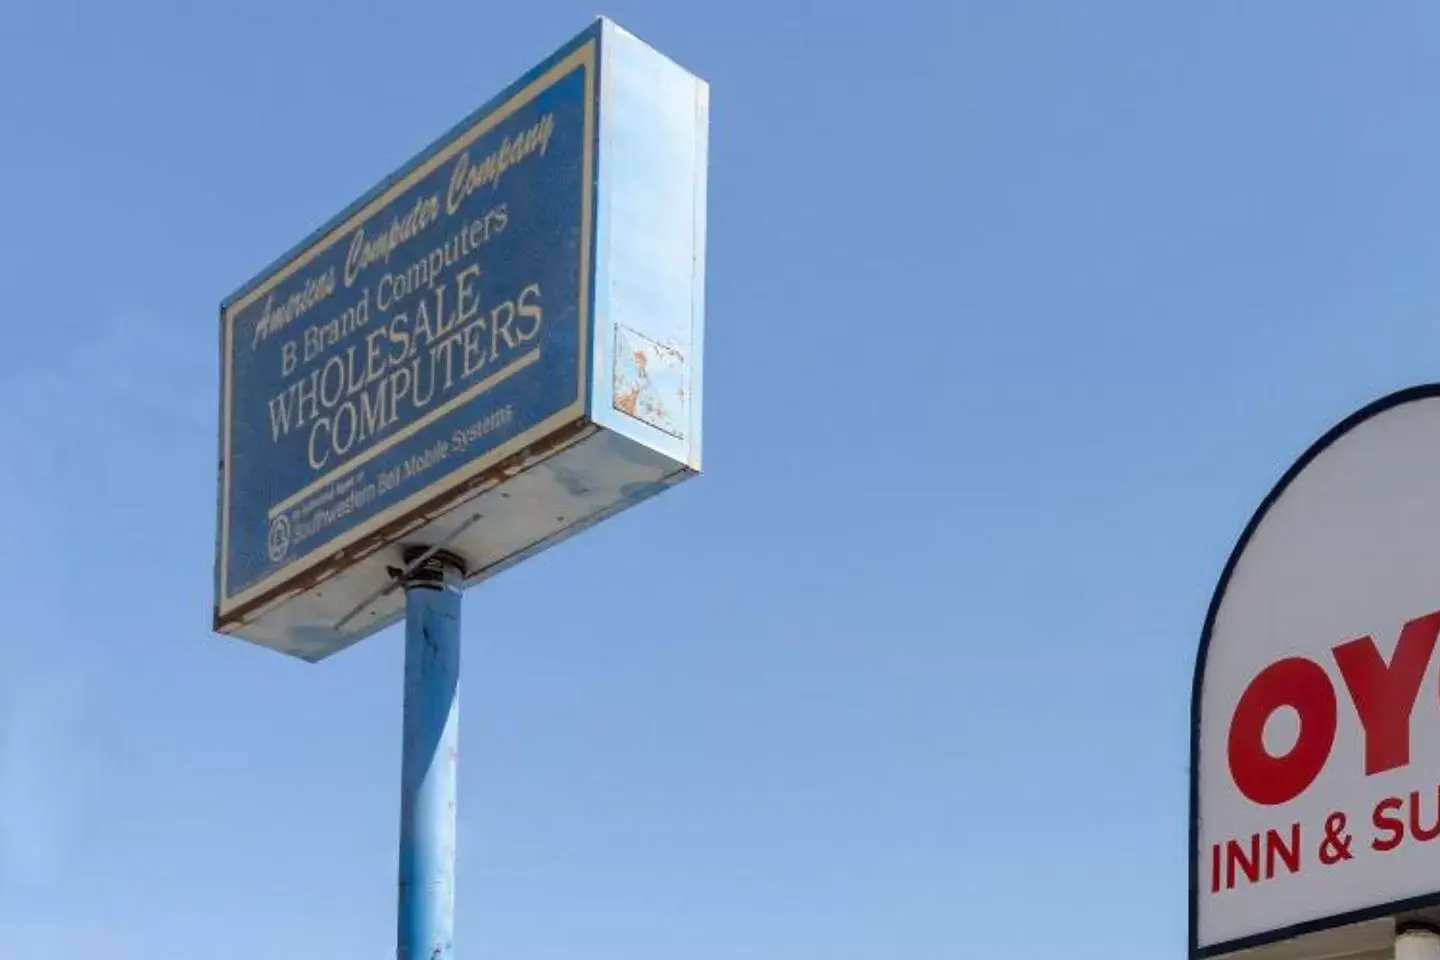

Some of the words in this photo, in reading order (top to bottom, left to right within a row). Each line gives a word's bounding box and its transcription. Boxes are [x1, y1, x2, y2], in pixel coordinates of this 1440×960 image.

[344, 228, 439, 288] Computer
[446, 113, 554, 215] Company
[267, 264, 481, 443] WHOLESALE
[281, 340, 298, 377] B
[303, 288, 370, 363] Brand
[376, 203, 508, 311] Computers
[308, 283, 542, 470] COMPUTERS
[403, 438, 450, 480] Mobile
[451, 404, 514, 455] Systems
[1211, 822, 1301, 894] INN
[1318, 810, 1354, 866] &
